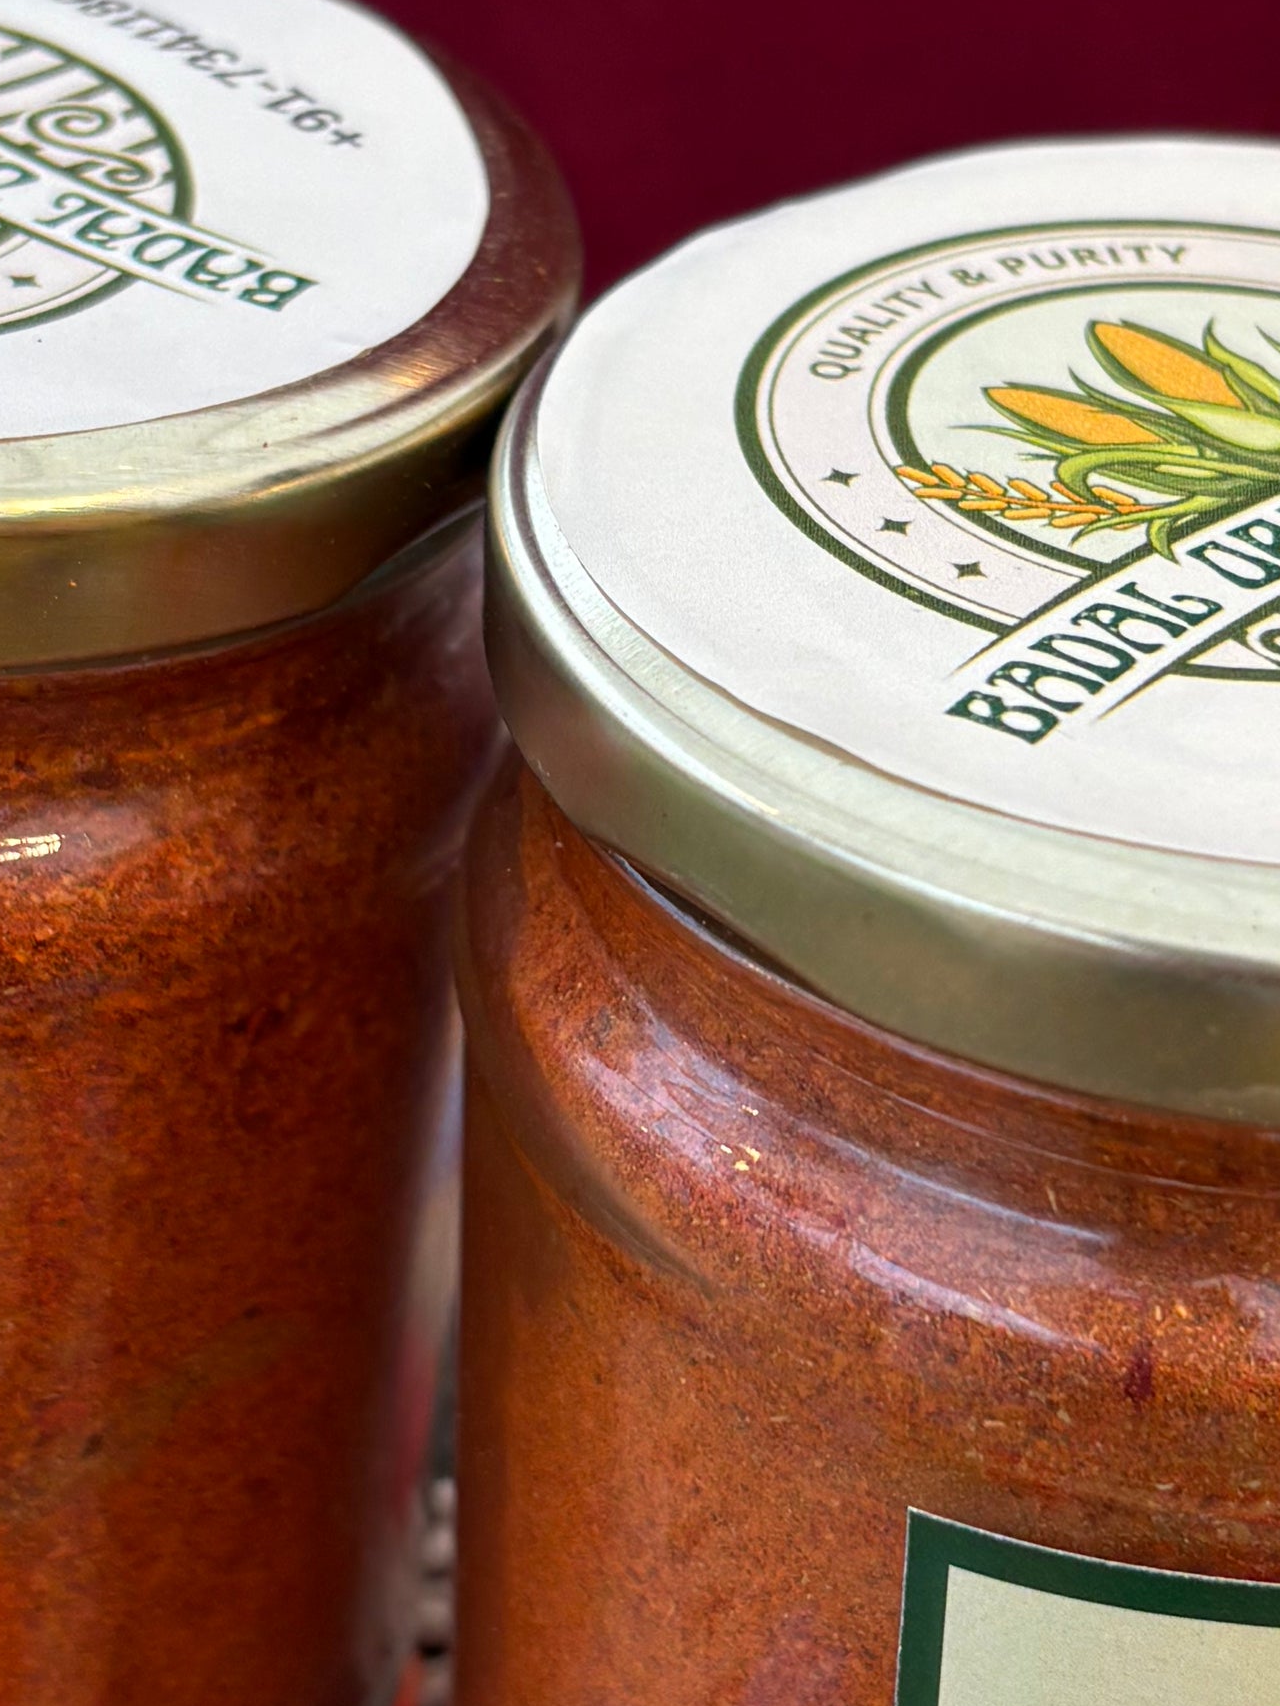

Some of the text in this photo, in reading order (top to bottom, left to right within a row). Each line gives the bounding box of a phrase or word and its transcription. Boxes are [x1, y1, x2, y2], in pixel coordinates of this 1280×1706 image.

[33, 192, 320, 312] BADAL
[809, 244, 1191, 380] QUALITY & PURITY
[945, 579, 1223, 746] BADAL
